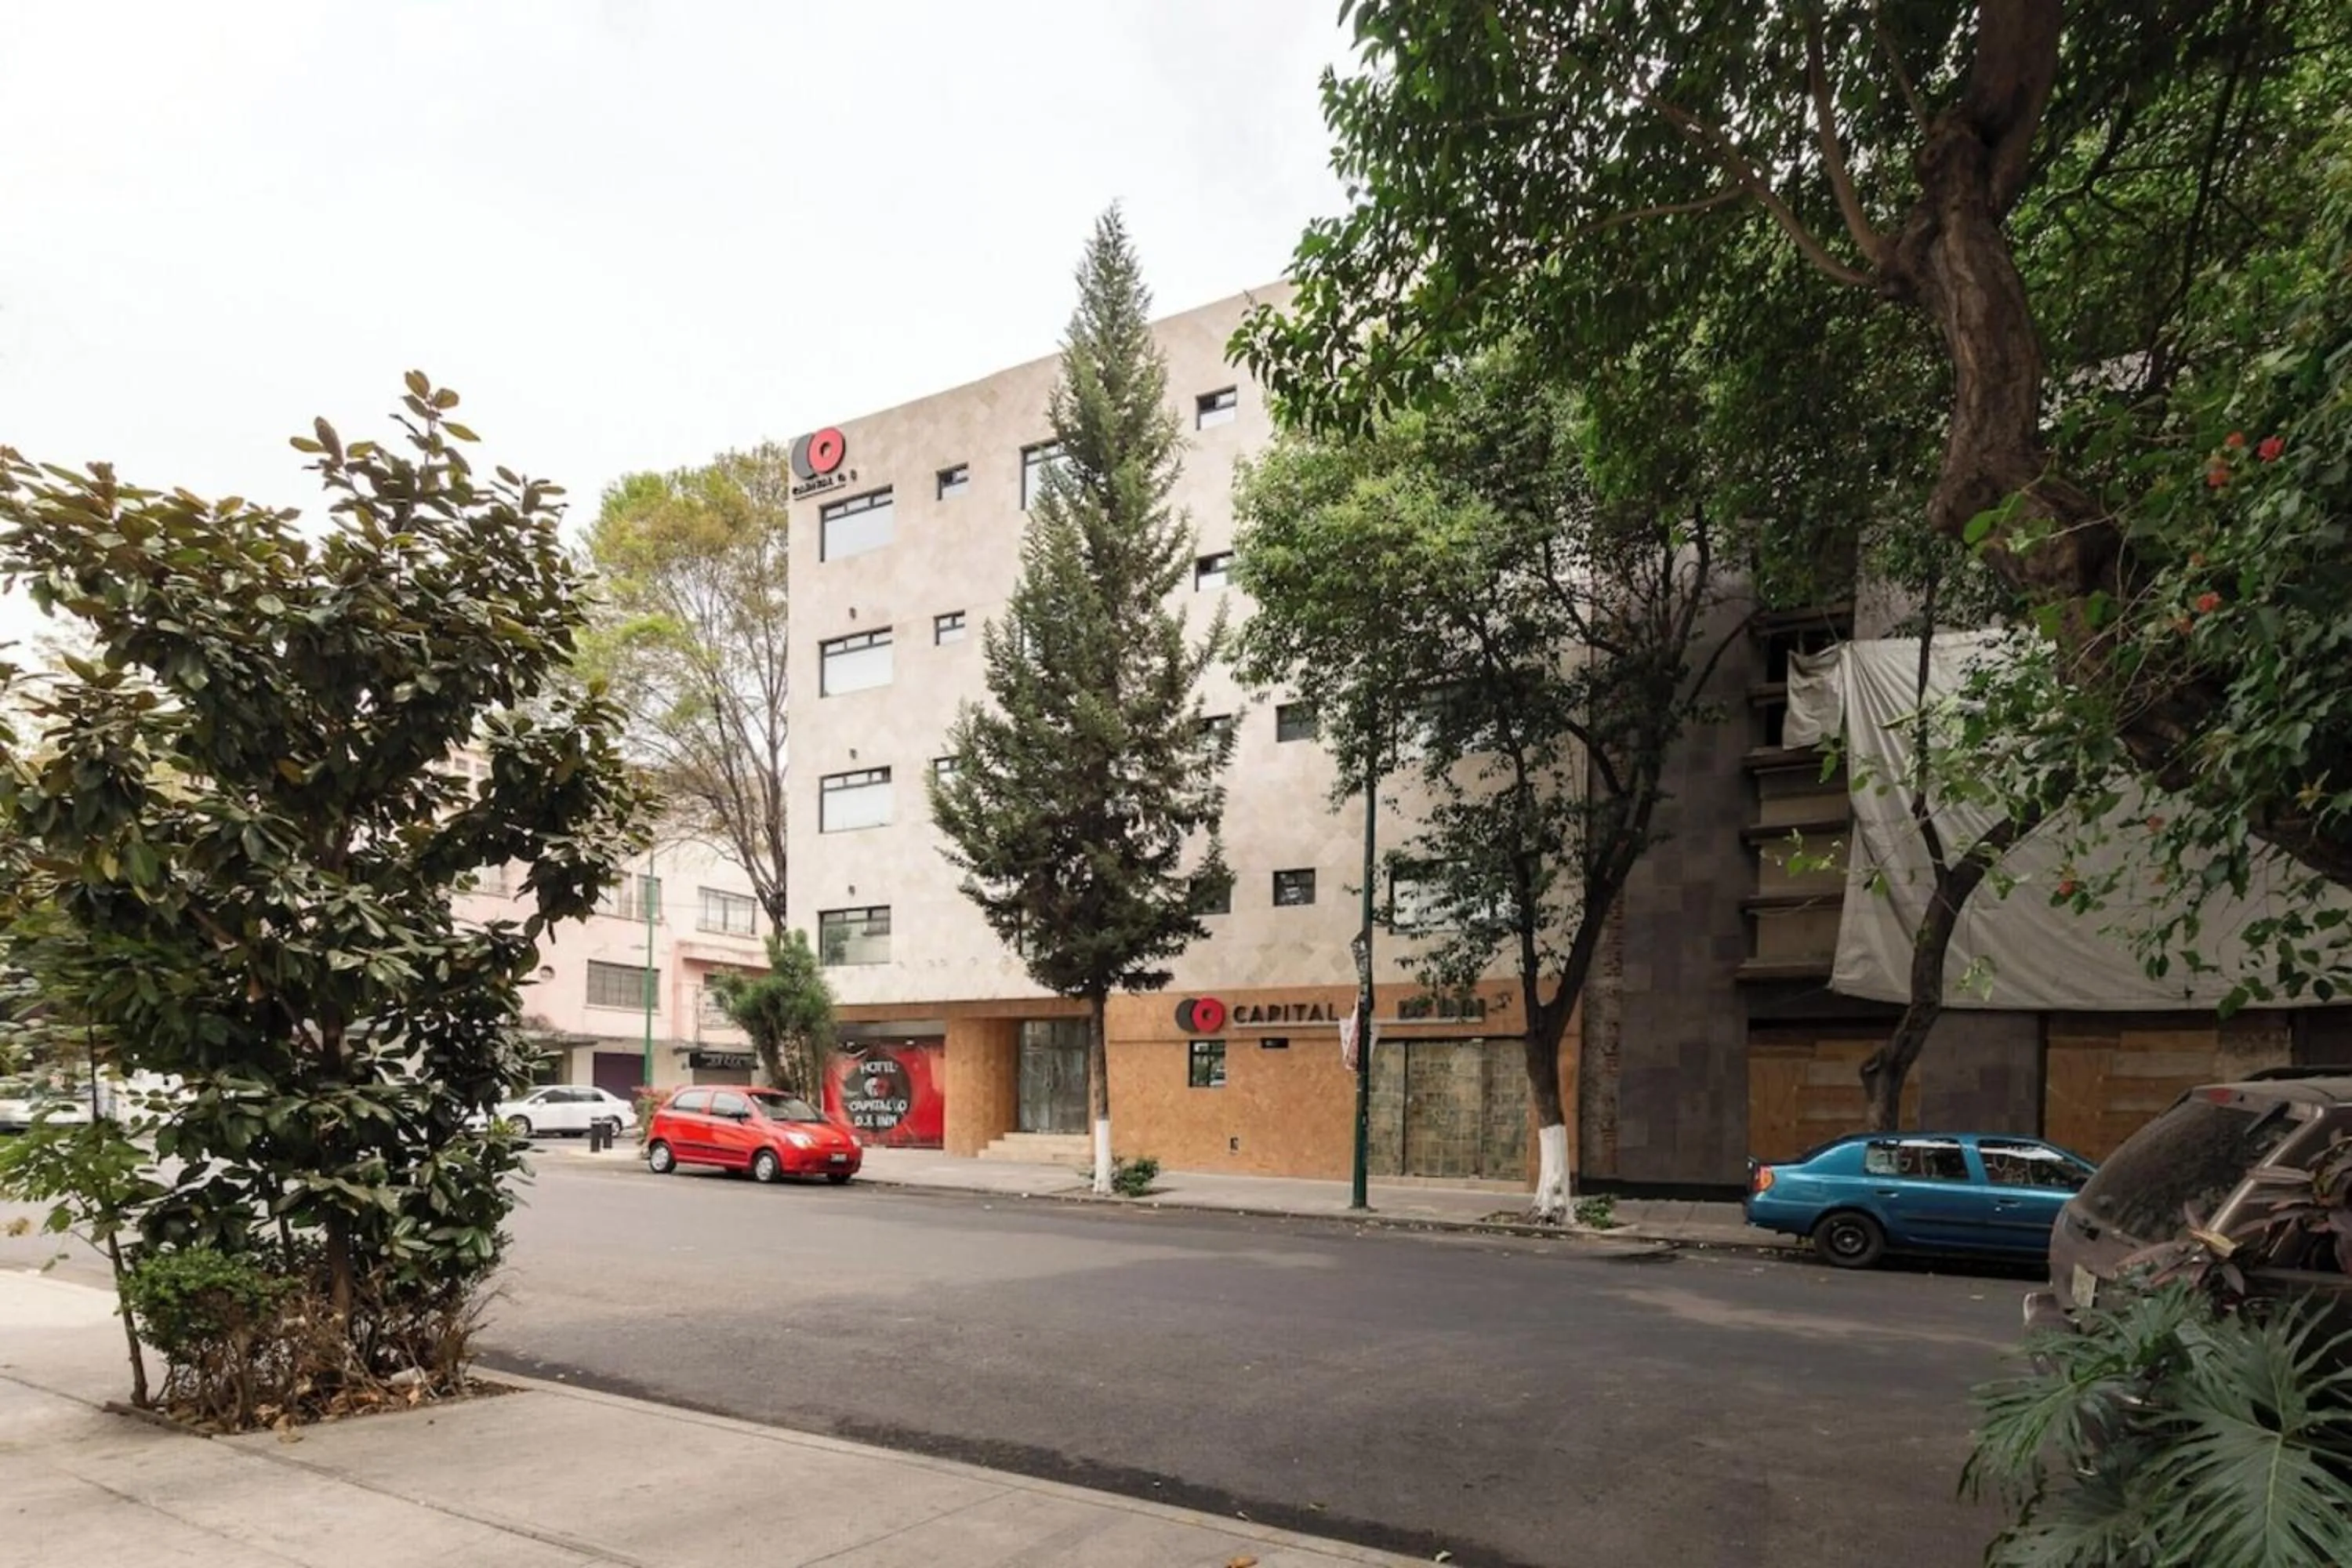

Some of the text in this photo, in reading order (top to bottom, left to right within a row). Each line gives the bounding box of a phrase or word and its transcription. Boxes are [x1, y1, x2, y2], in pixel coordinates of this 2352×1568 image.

[1233, 1003, 1339, 1023] CAPITAL
[860, 1061, 896, 1075] HOTEL
[848, 1099, 892, 1112] CAPITAL
